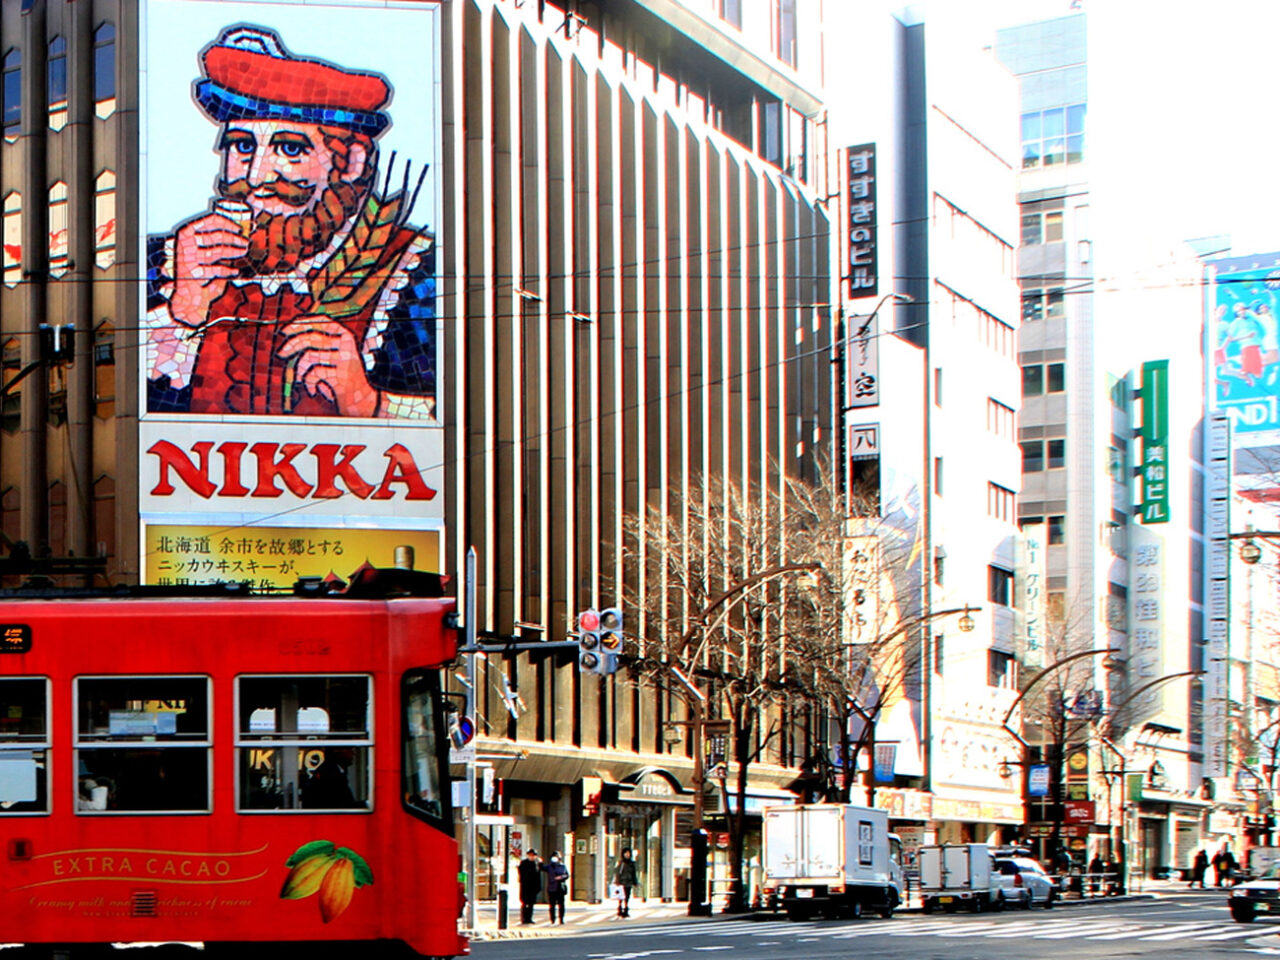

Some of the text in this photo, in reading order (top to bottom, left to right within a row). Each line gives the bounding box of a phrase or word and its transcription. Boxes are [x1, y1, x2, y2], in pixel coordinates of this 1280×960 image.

[147, 440, 437, 500] NIKKA
[156, 536, 344, 556] 北海道 余市を故郷とする
[53, 857, 230, 876] EXTRA CACAO
